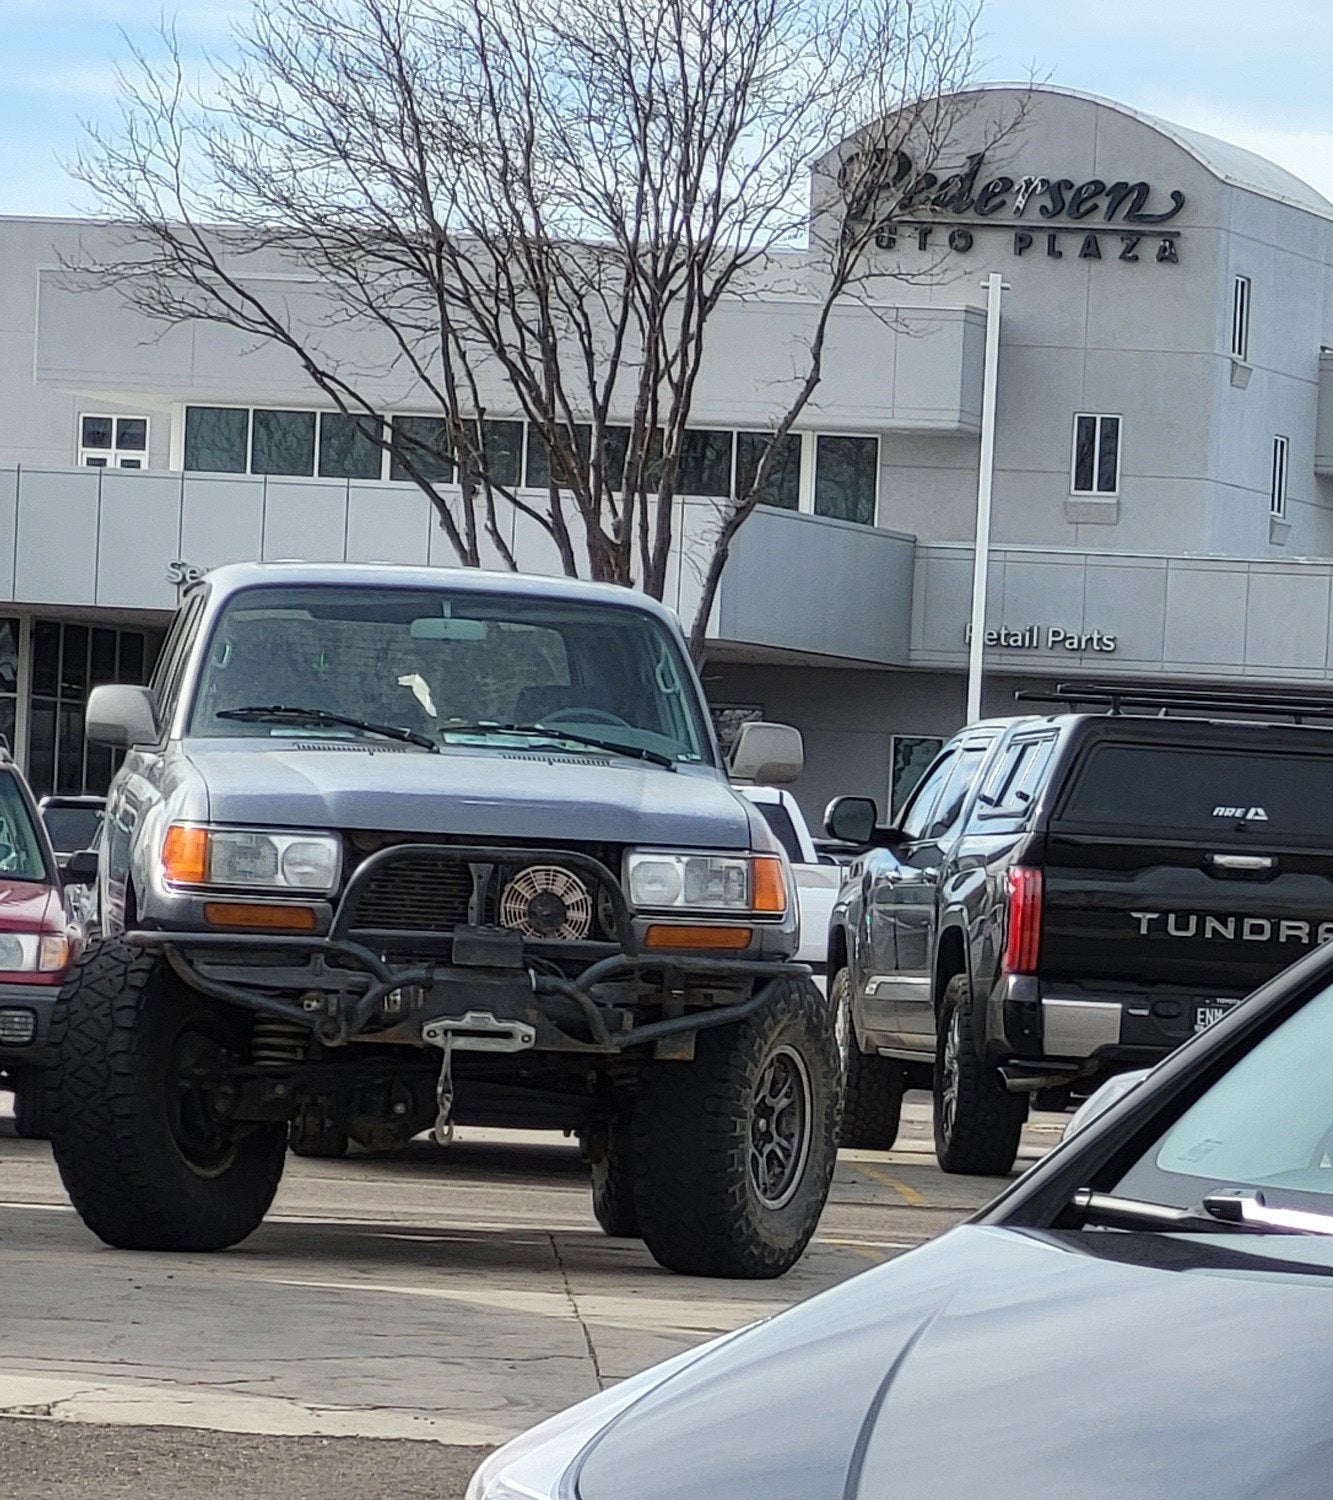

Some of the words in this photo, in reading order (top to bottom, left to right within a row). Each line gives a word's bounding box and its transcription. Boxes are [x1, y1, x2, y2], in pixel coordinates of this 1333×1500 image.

[838, 148, 1185, 224] Pedersen
[1014, 231, 1178, 263] PLAZA
[1047, 627, 1117, 652] Parts
